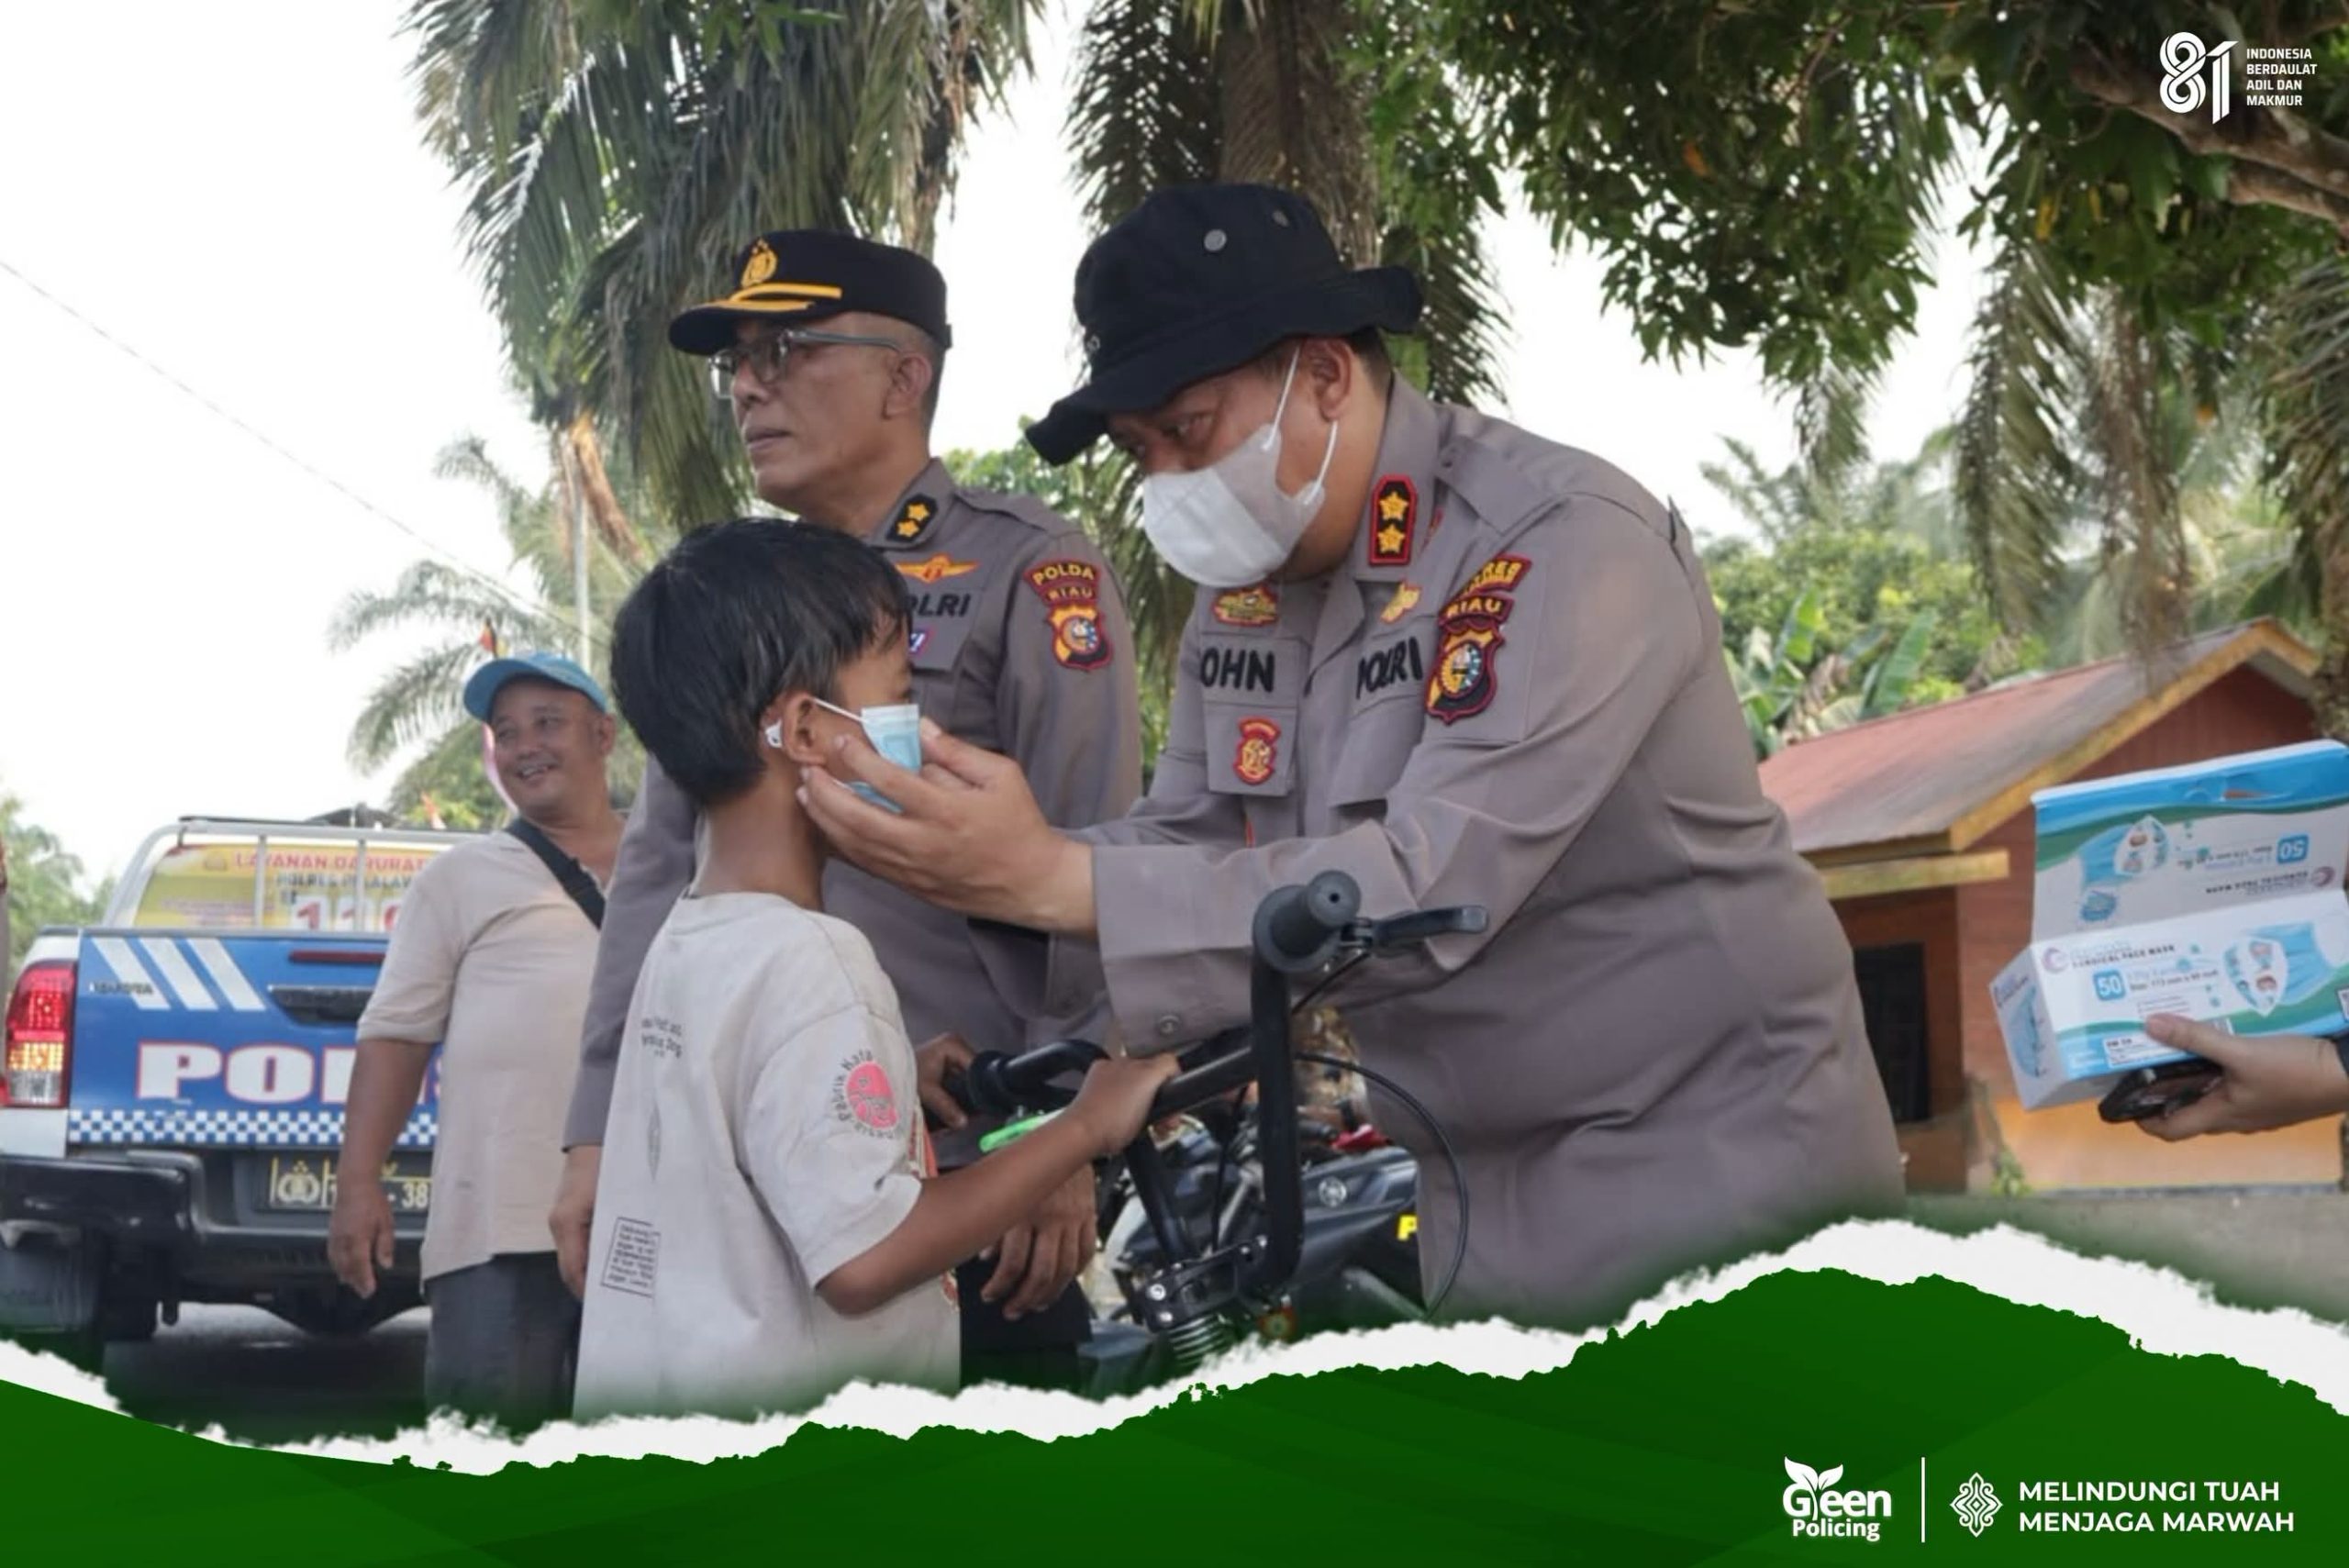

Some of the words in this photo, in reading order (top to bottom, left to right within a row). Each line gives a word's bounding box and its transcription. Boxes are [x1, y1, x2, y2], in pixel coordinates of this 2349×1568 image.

[1032, 563, 1095, 586] POLDA
[1047, 587, 1094, 602] RIAU
[1446, 597, 1503, 619] RIAU
[1355, 636, 1424, 701] POLRI
[2096, 976, 2124, 998] 50
